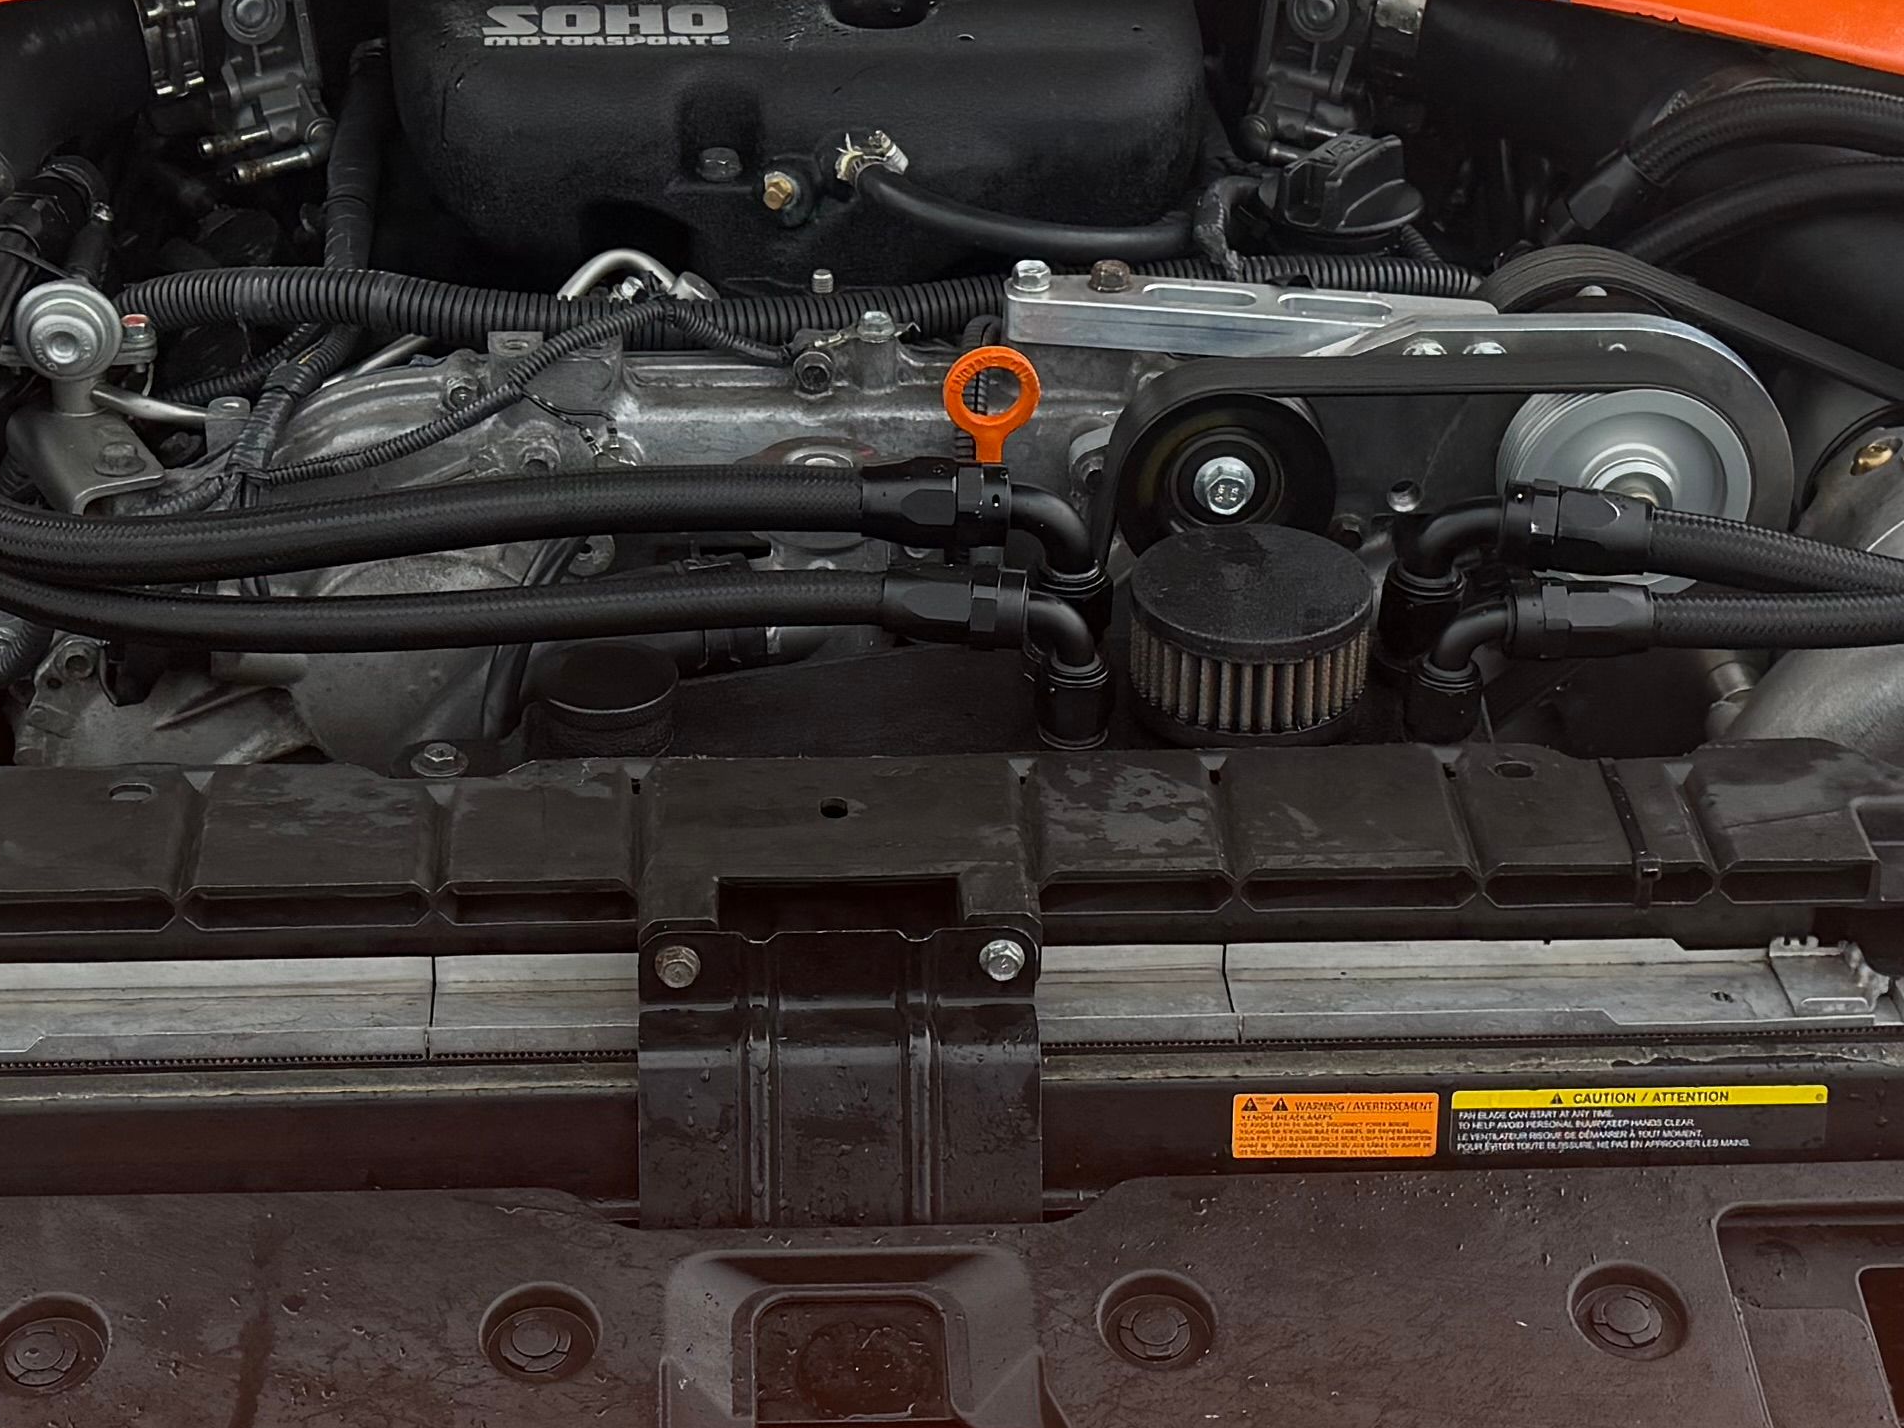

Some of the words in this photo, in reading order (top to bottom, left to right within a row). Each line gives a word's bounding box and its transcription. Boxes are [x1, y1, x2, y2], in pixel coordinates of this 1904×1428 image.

[482, 5, 729, 35] SOHO
[483, 35, 731, 47] MOTORSPORTS
[1573, 1092, 1636, 1104] CAUTION
[1641, 1092, 1648, 1102] /
[1652, 1091, 1729, 1103] ATTENTION
[1295, 1101, 1345, 1111] WARNING
[1508, 1110, 1528, 1119] CAN
[1571, 1109, 1590, 1118] ANY
[1458, 1121, 1470, 1130] TO
[1472, 1121, 1496, 1130] HELP
[1497, 1121, 1525, 1129] AVOID
